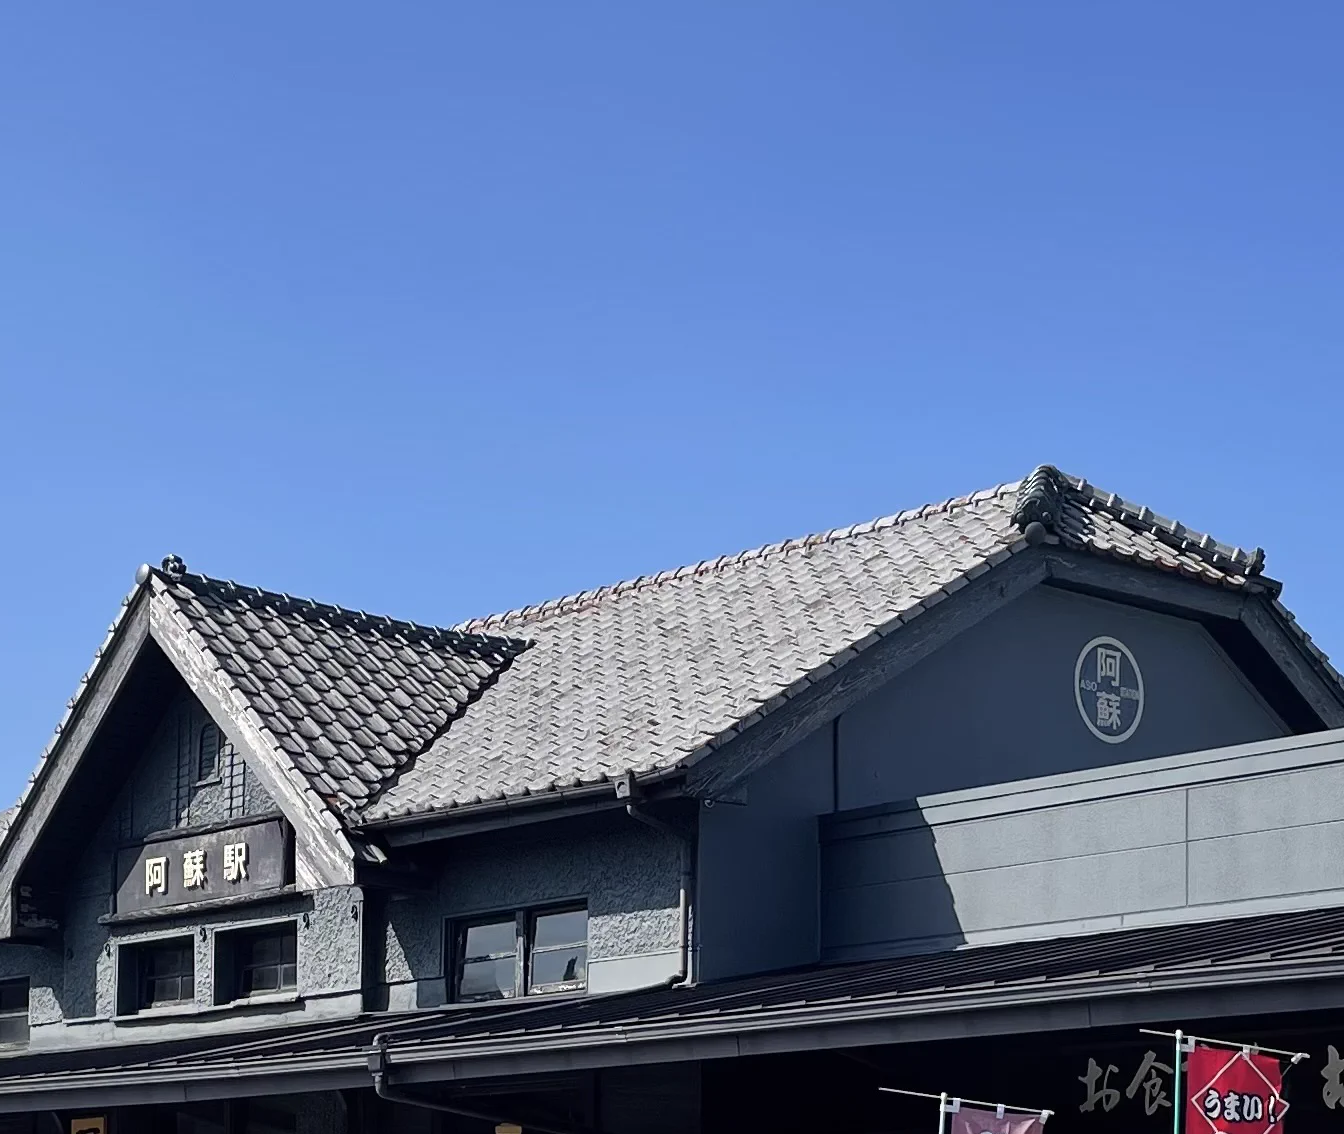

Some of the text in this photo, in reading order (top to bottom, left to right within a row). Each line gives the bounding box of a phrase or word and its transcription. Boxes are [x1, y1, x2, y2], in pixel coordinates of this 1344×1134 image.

[1097, 647, 1121, 730] 阿蘇
[145, 842, 248, 895] 阿蘇駅
